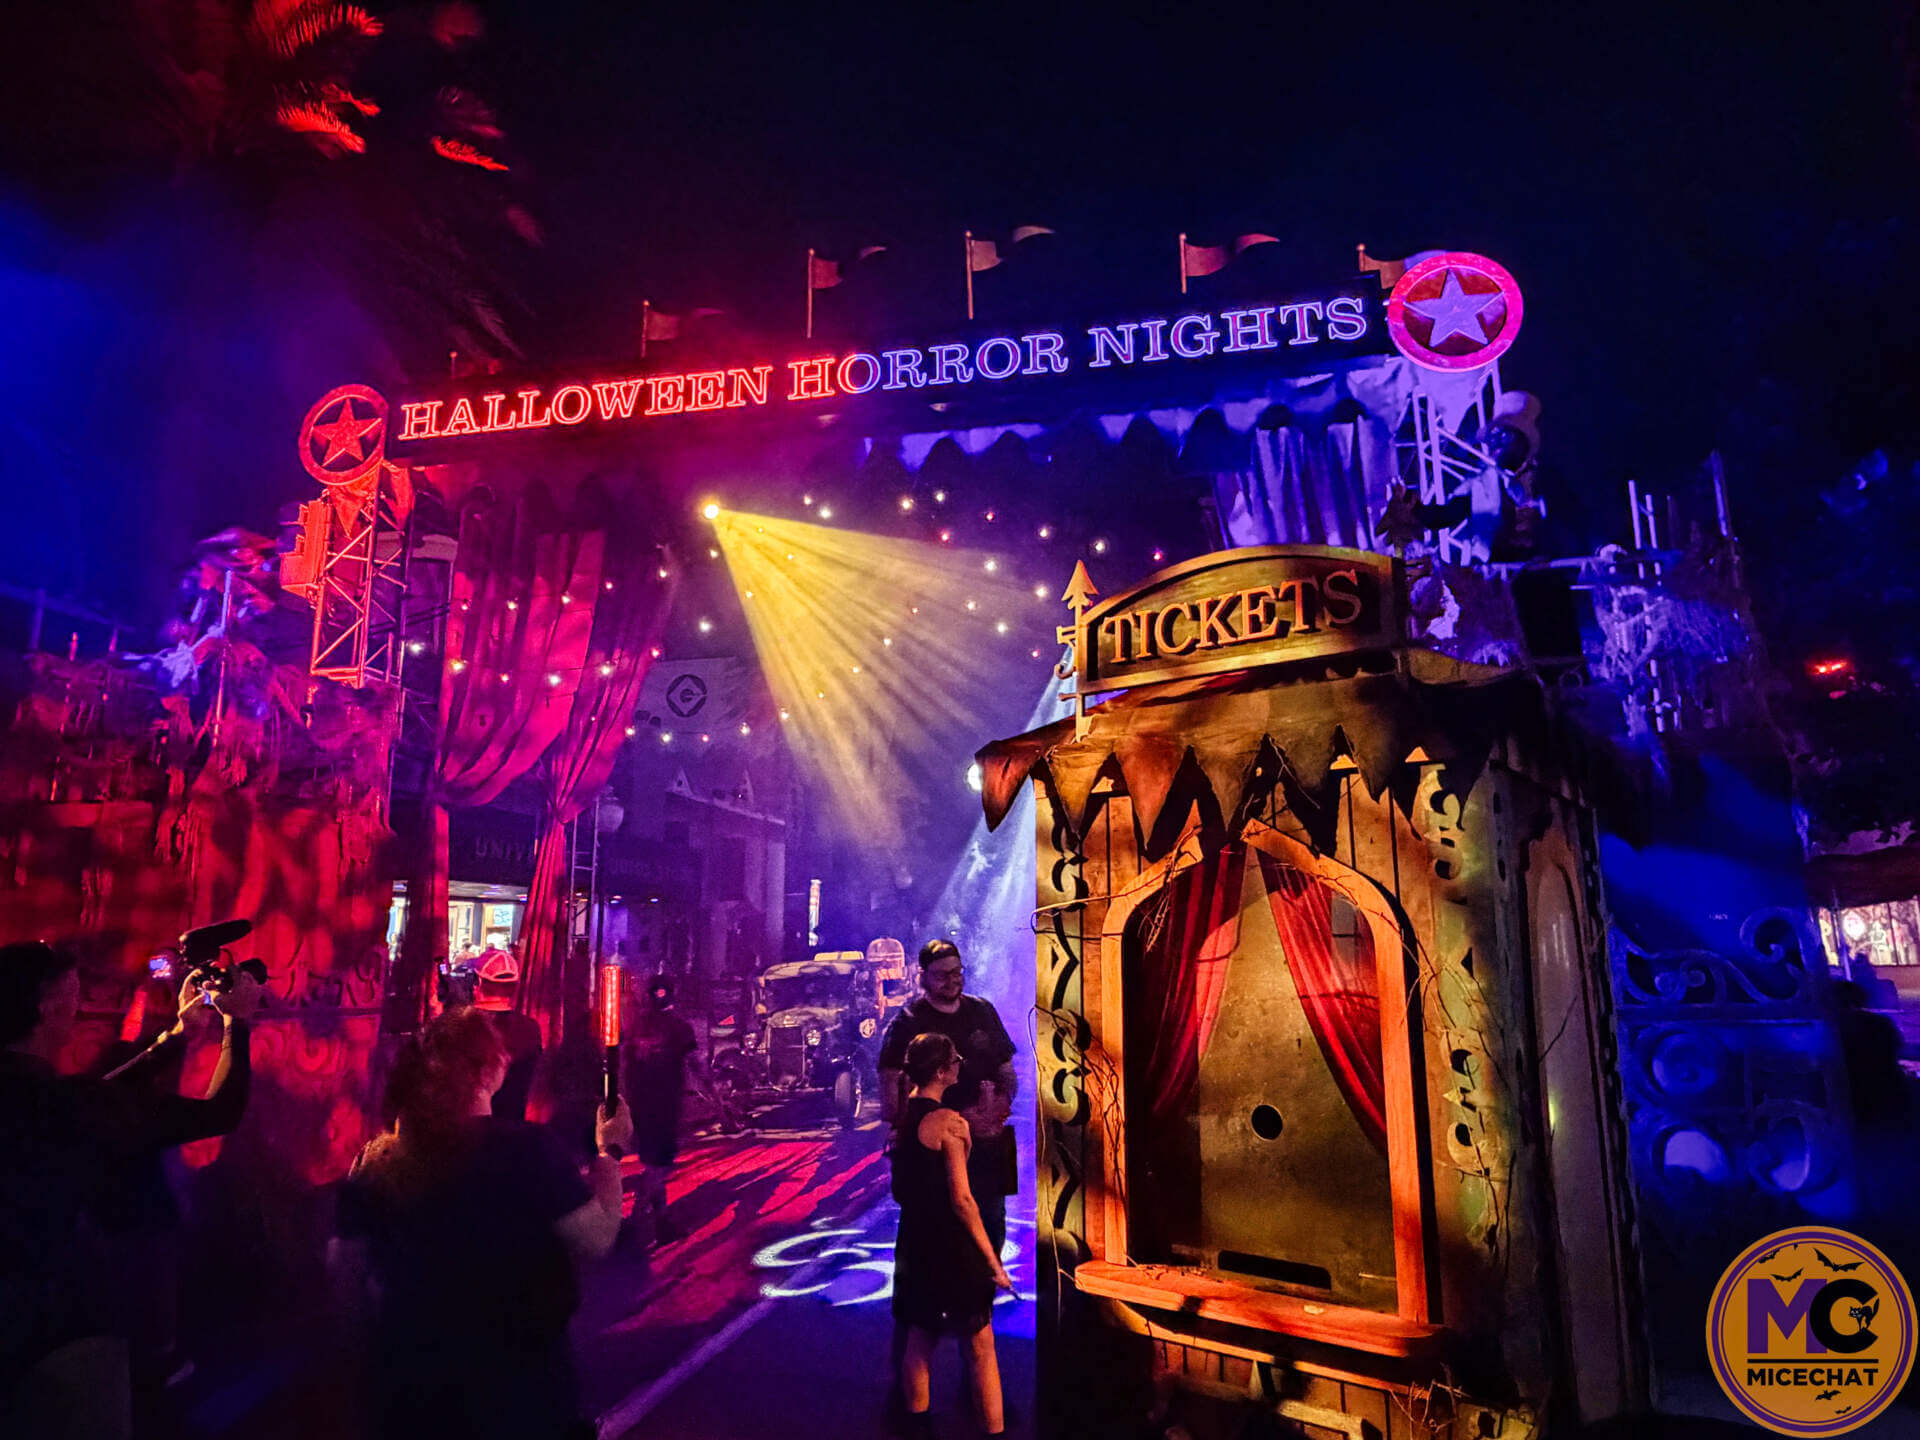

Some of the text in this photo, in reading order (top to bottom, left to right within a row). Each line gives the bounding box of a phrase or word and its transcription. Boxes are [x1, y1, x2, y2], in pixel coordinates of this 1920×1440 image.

[398, 297, 1368, 440] HALLOWEEN HORROR NIGHTS
[1102, 569, 1362, 664] TICKETS
